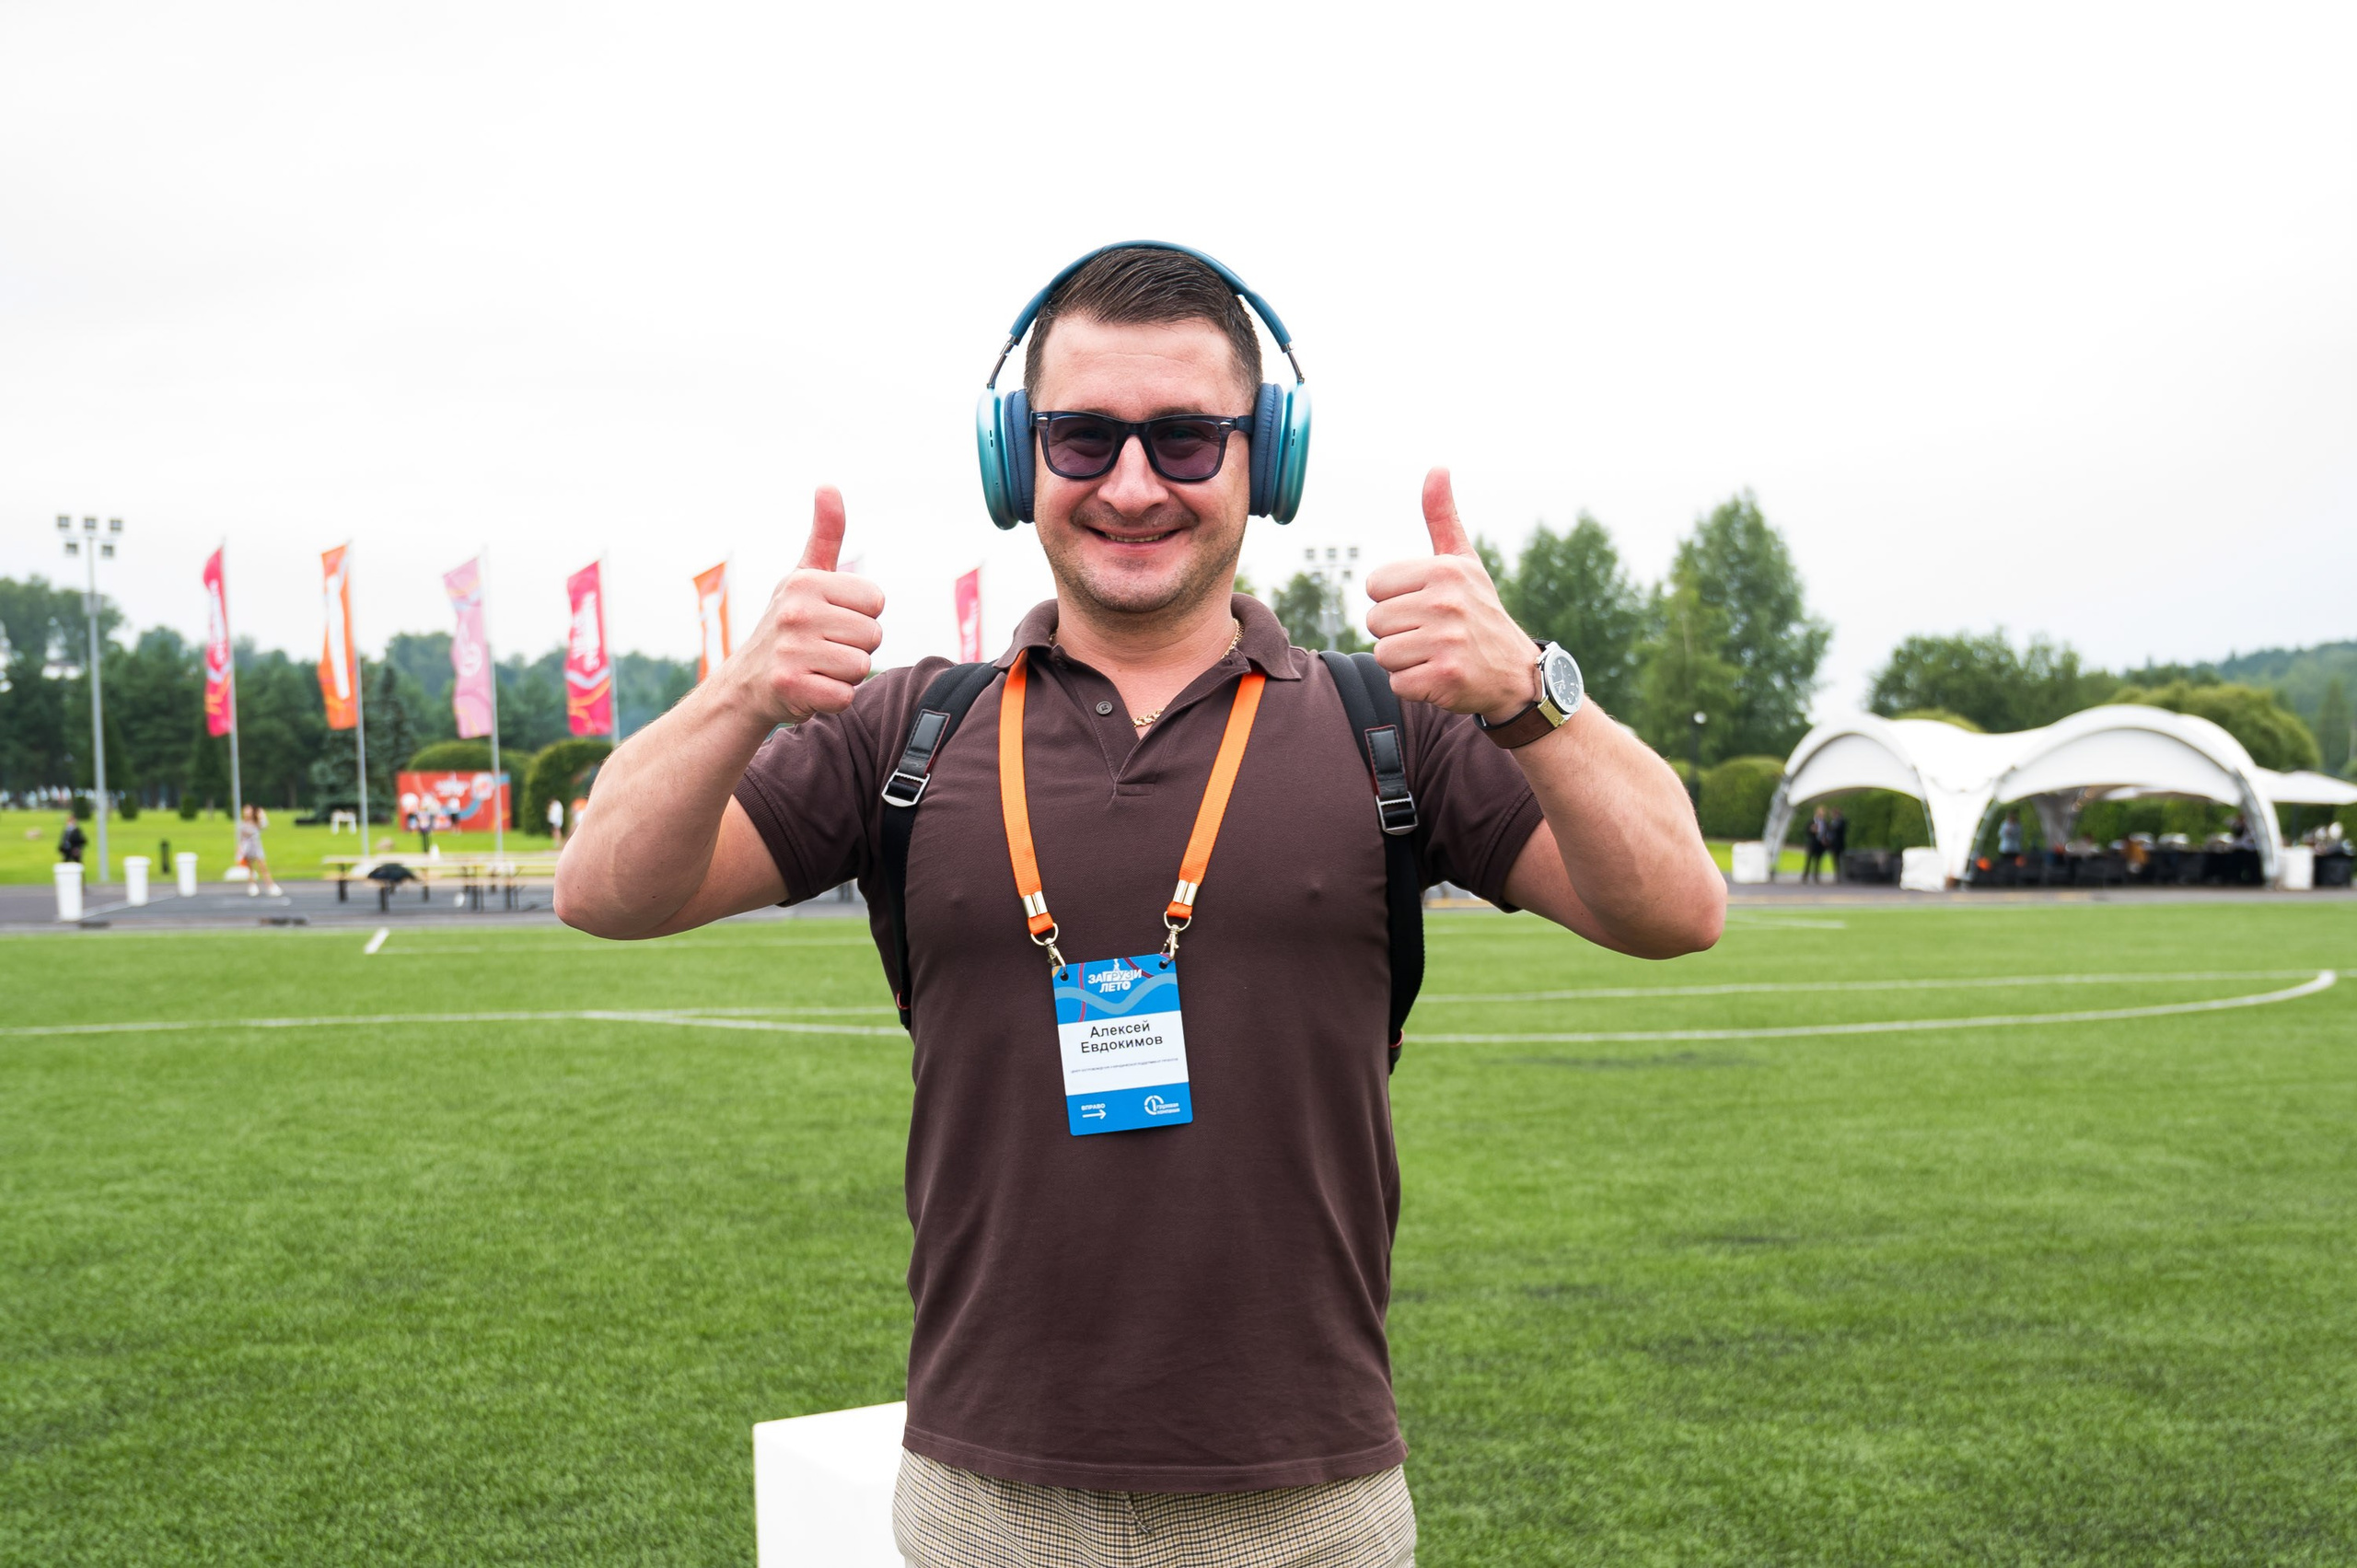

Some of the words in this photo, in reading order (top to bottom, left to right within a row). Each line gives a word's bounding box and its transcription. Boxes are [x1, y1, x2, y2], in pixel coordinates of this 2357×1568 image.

[1087, 970, 1143, 984] ЗАГРУЗИ
[1099, 981, 1131, 993] ЛЕТО
[1090, 1019, 1150, 1038] Алексей
[1081, 1036, 1163, 1053] Евдокимов
